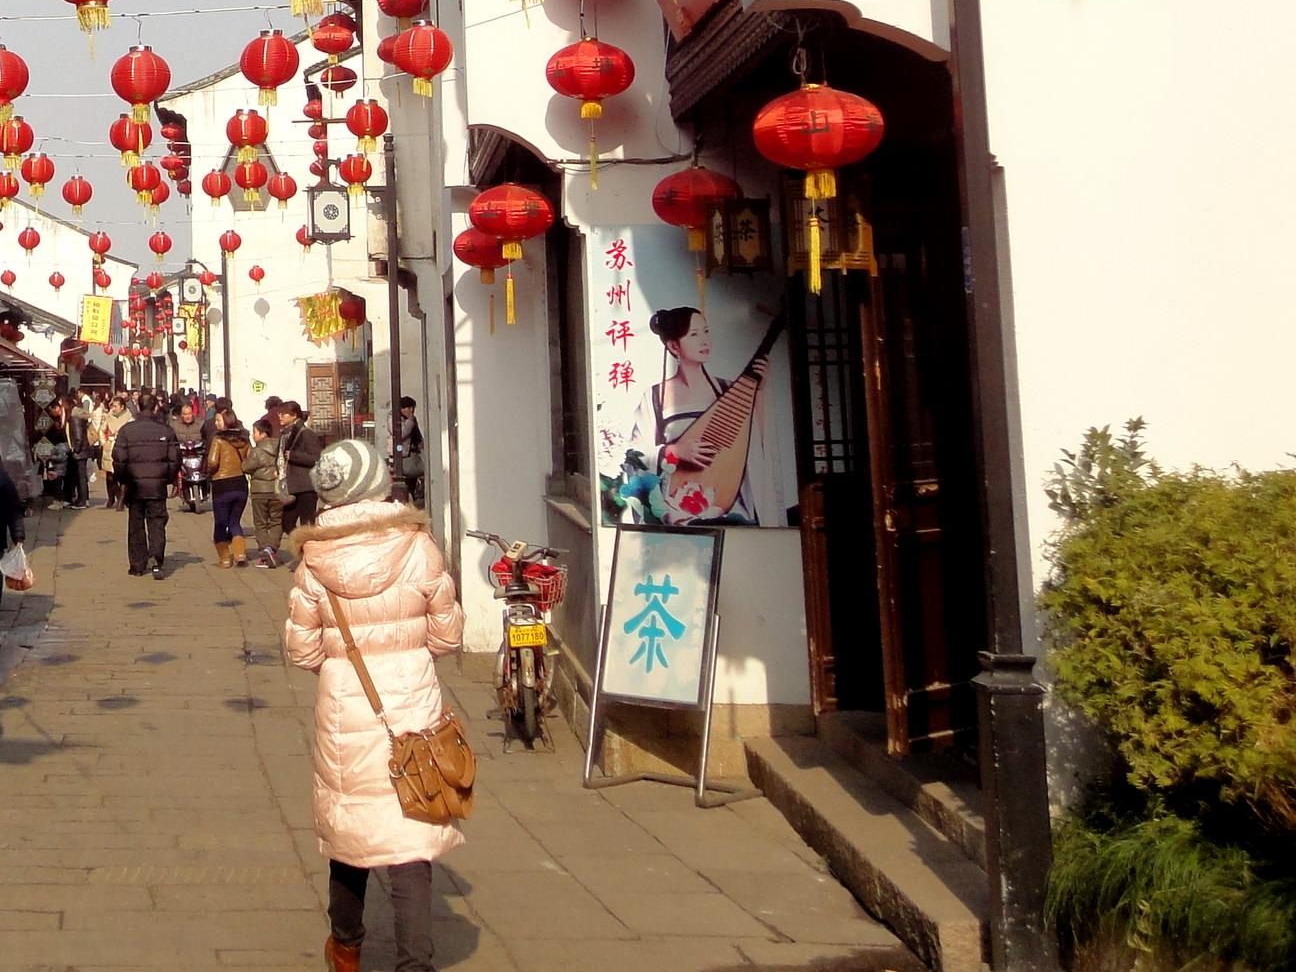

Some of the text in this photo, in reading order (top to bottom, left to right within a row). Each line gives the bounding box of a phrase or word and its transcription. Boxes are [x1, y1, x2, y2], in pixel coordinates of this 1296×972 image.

[800, 110, 830, 135] 山
[605, 238, 637, 394] 苏州评弹
[624, 574, 686, 673] 茶
